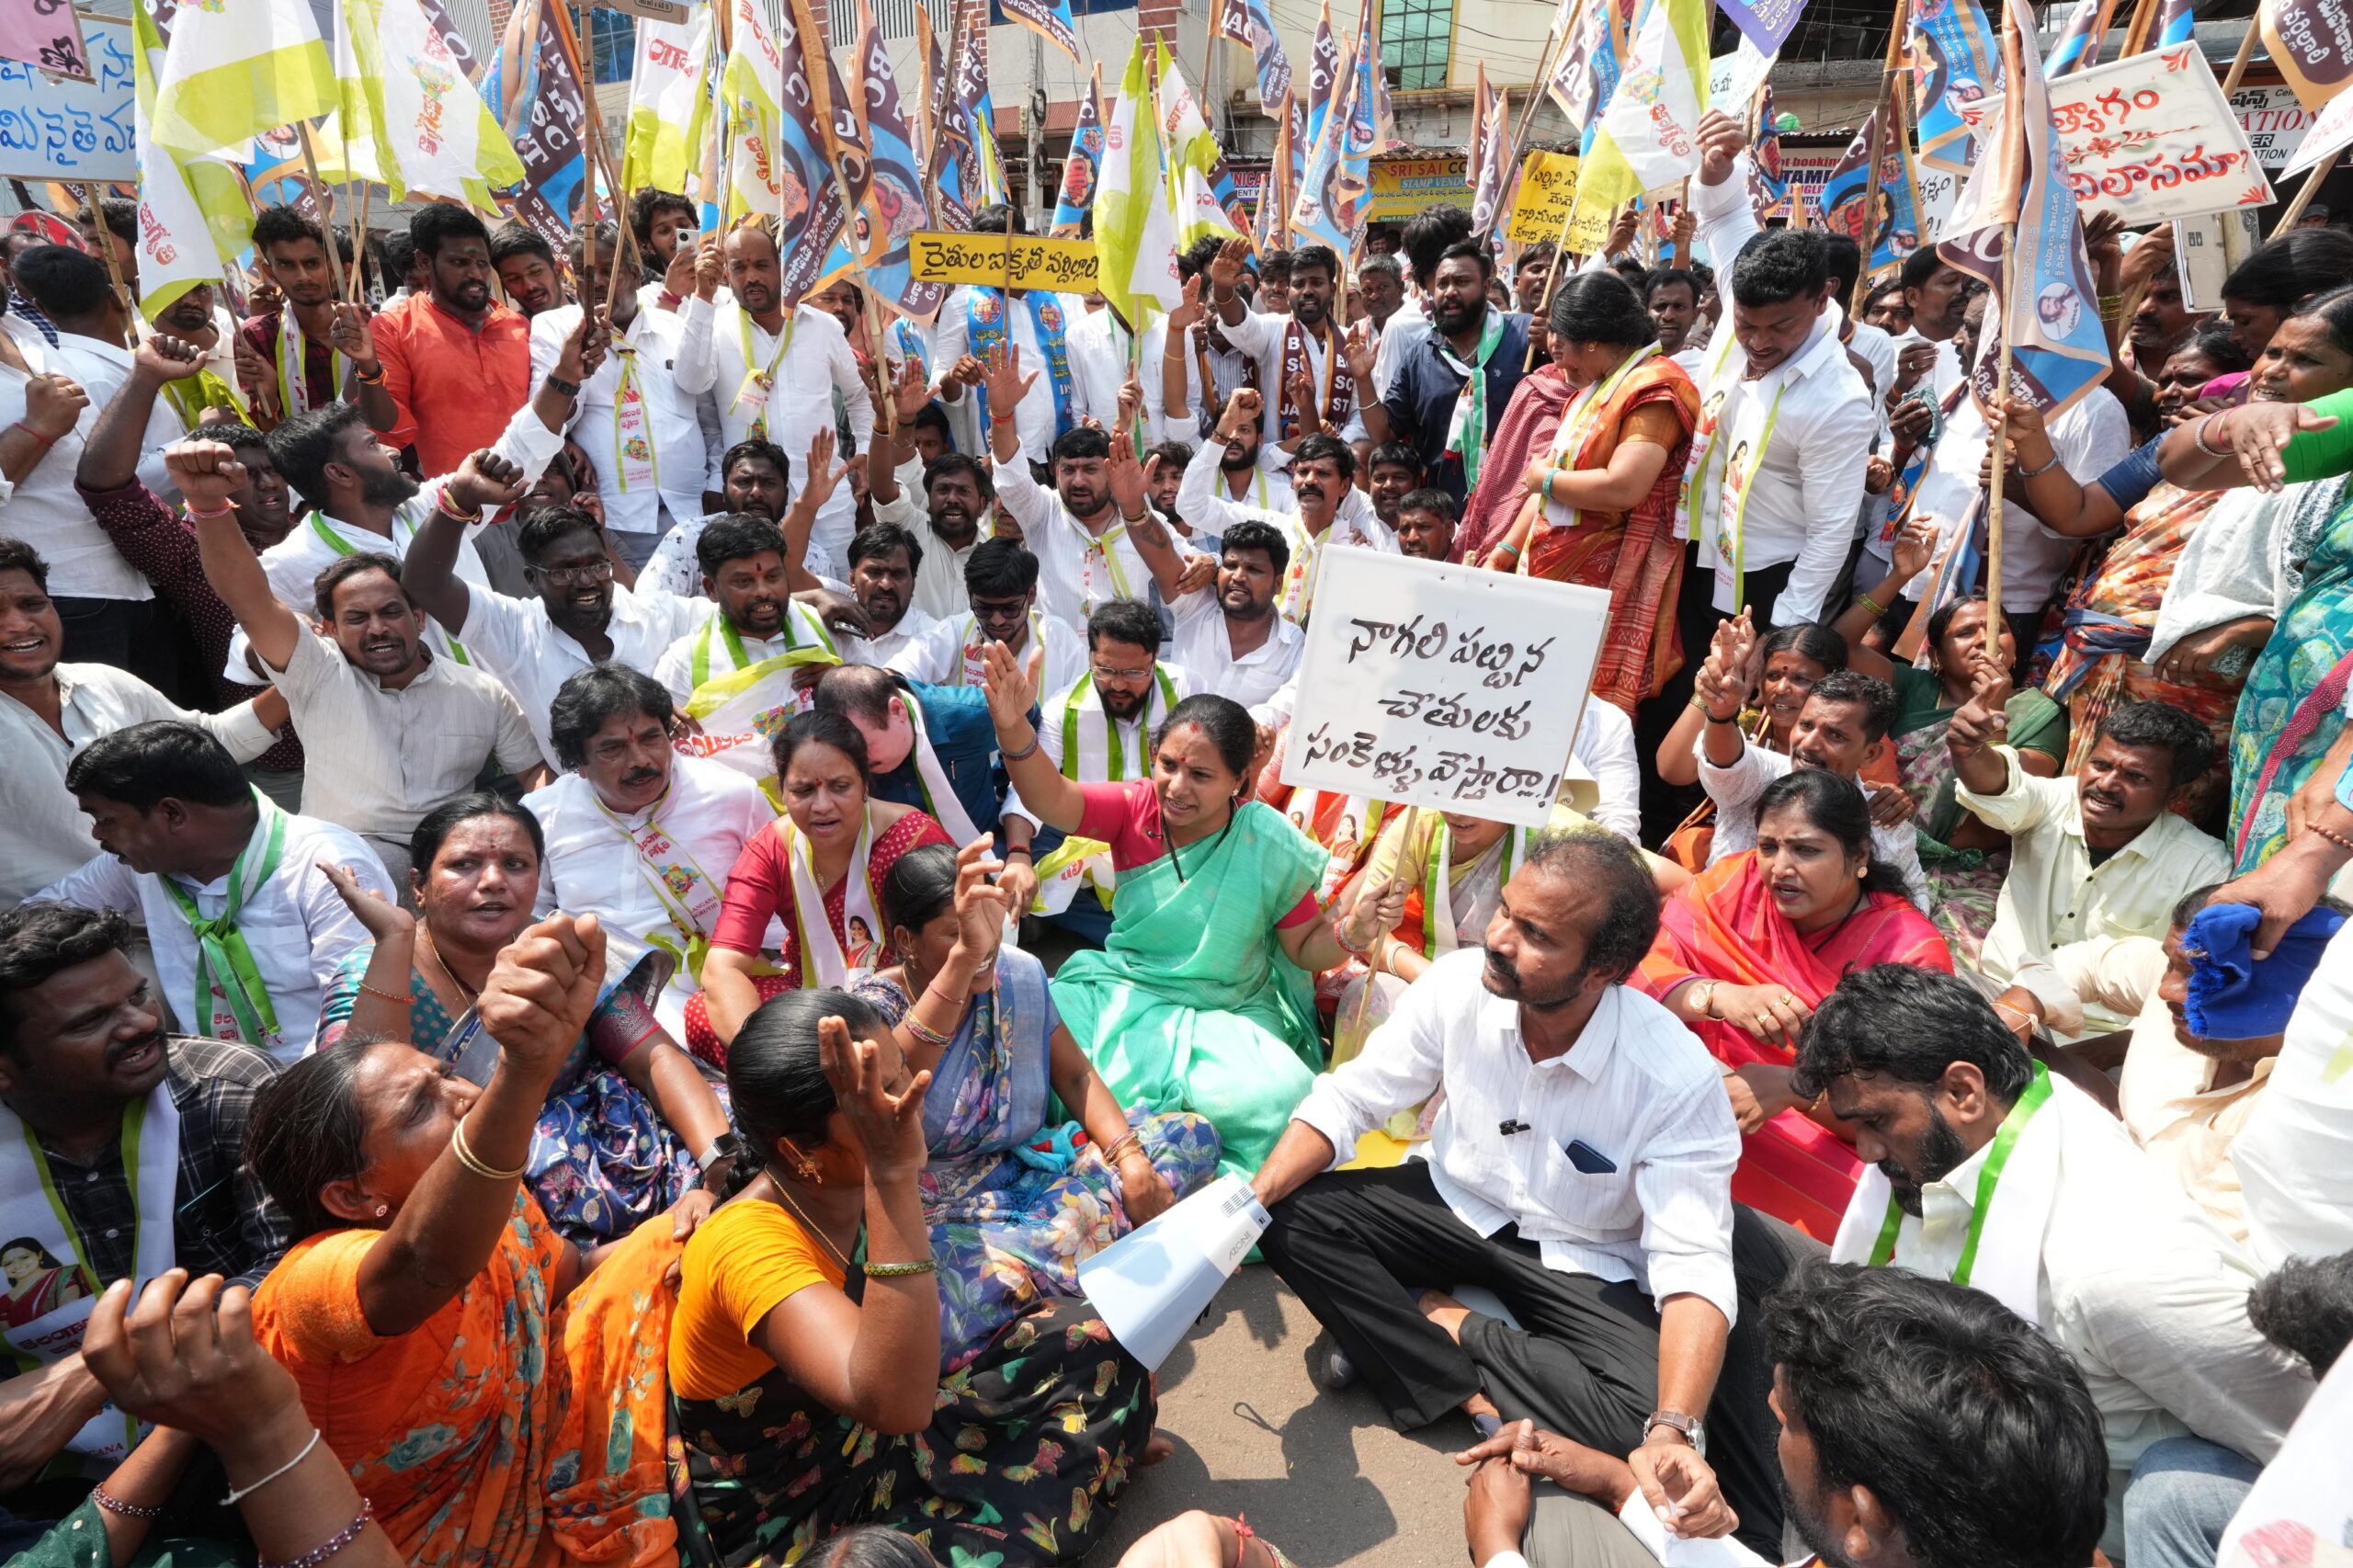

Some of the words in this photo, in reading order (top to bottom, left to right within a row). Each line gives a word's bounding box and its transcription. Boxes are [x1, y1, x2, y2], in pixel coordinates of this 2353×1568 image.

[1390, 164, 1412, 177] SRI
[1417, 162, 1442, 176] SAI
[1334, 375, 1354, 392] SC
[1332, 397, 1349, 413] ST
[1347, 614, 1449, 664] నాగలి
